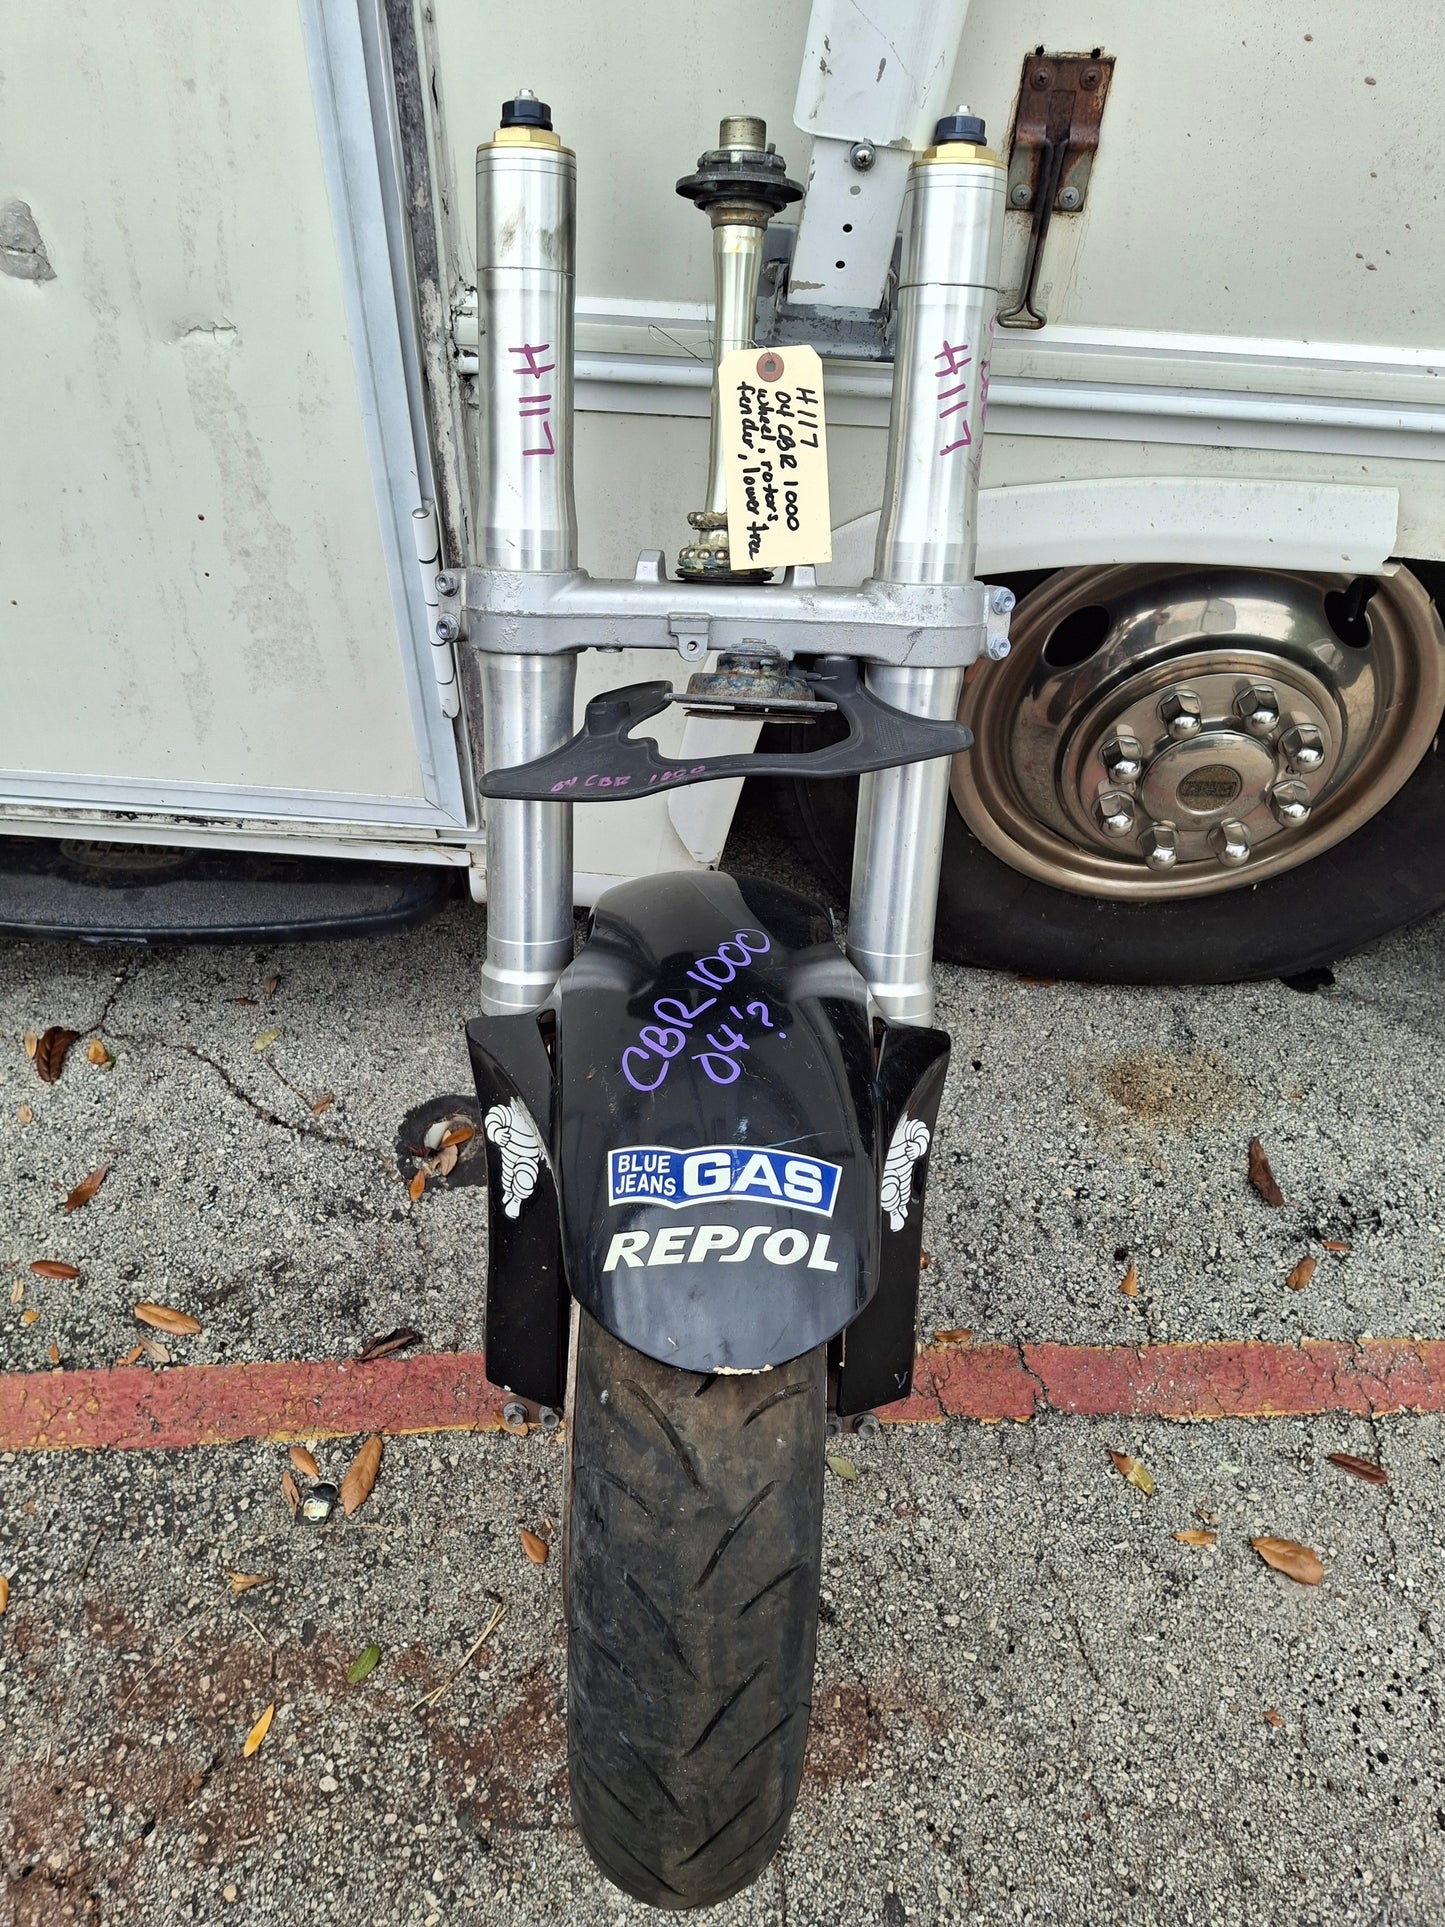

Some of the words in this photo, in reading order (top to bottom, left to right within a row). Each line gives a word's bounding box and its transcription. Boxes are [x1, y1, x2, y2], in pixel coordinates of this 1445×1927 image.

[508, 343, 555, 456] H117
[775, 390, 795, 418] 04
[796, 387, 819, 448] H117
[934, 340, 972, 456] H117
[777, 423, 798, 469] CBR
[743, 467, 761, 515] lower
[761, 460, 778, 522] rotors
[784, 480, 800, 531] 1000
[747, 521, 769, 561] tree
[584, 774, 631, 787] CBR
[648, 765, 705, 784] 1000
[622, 998, 717, 1091] CBR
[686, 928, 771, 990] 1000
[615, 1173, 676, 1196] JEANS
[618, 1154, 671, 1174] BLUE
[683, 1152, 822, 1204] GAS
[602, 1225, 839, 1272] REPSOL
